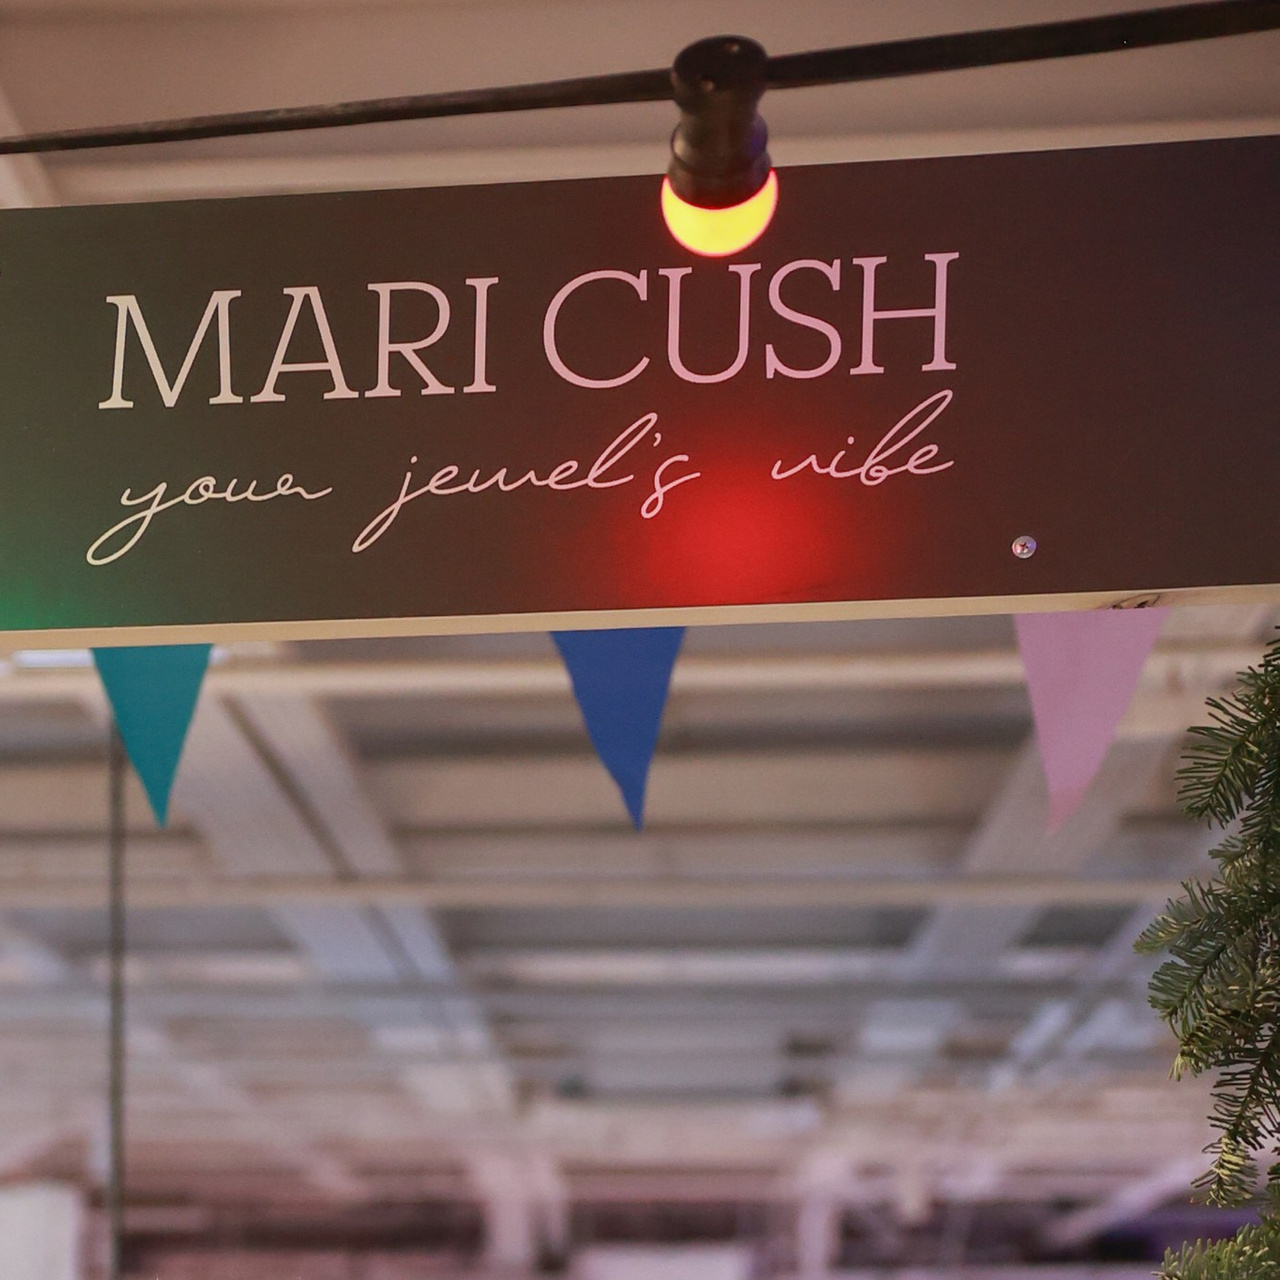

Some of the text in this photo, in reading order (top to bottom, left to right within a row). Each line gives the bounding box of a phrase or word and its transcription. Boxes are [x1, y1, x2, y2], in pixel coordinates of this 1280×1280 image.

[98, 251, 960, 410] MARI CUSH
[86, 389, 955, 566] your jewel's vibe
